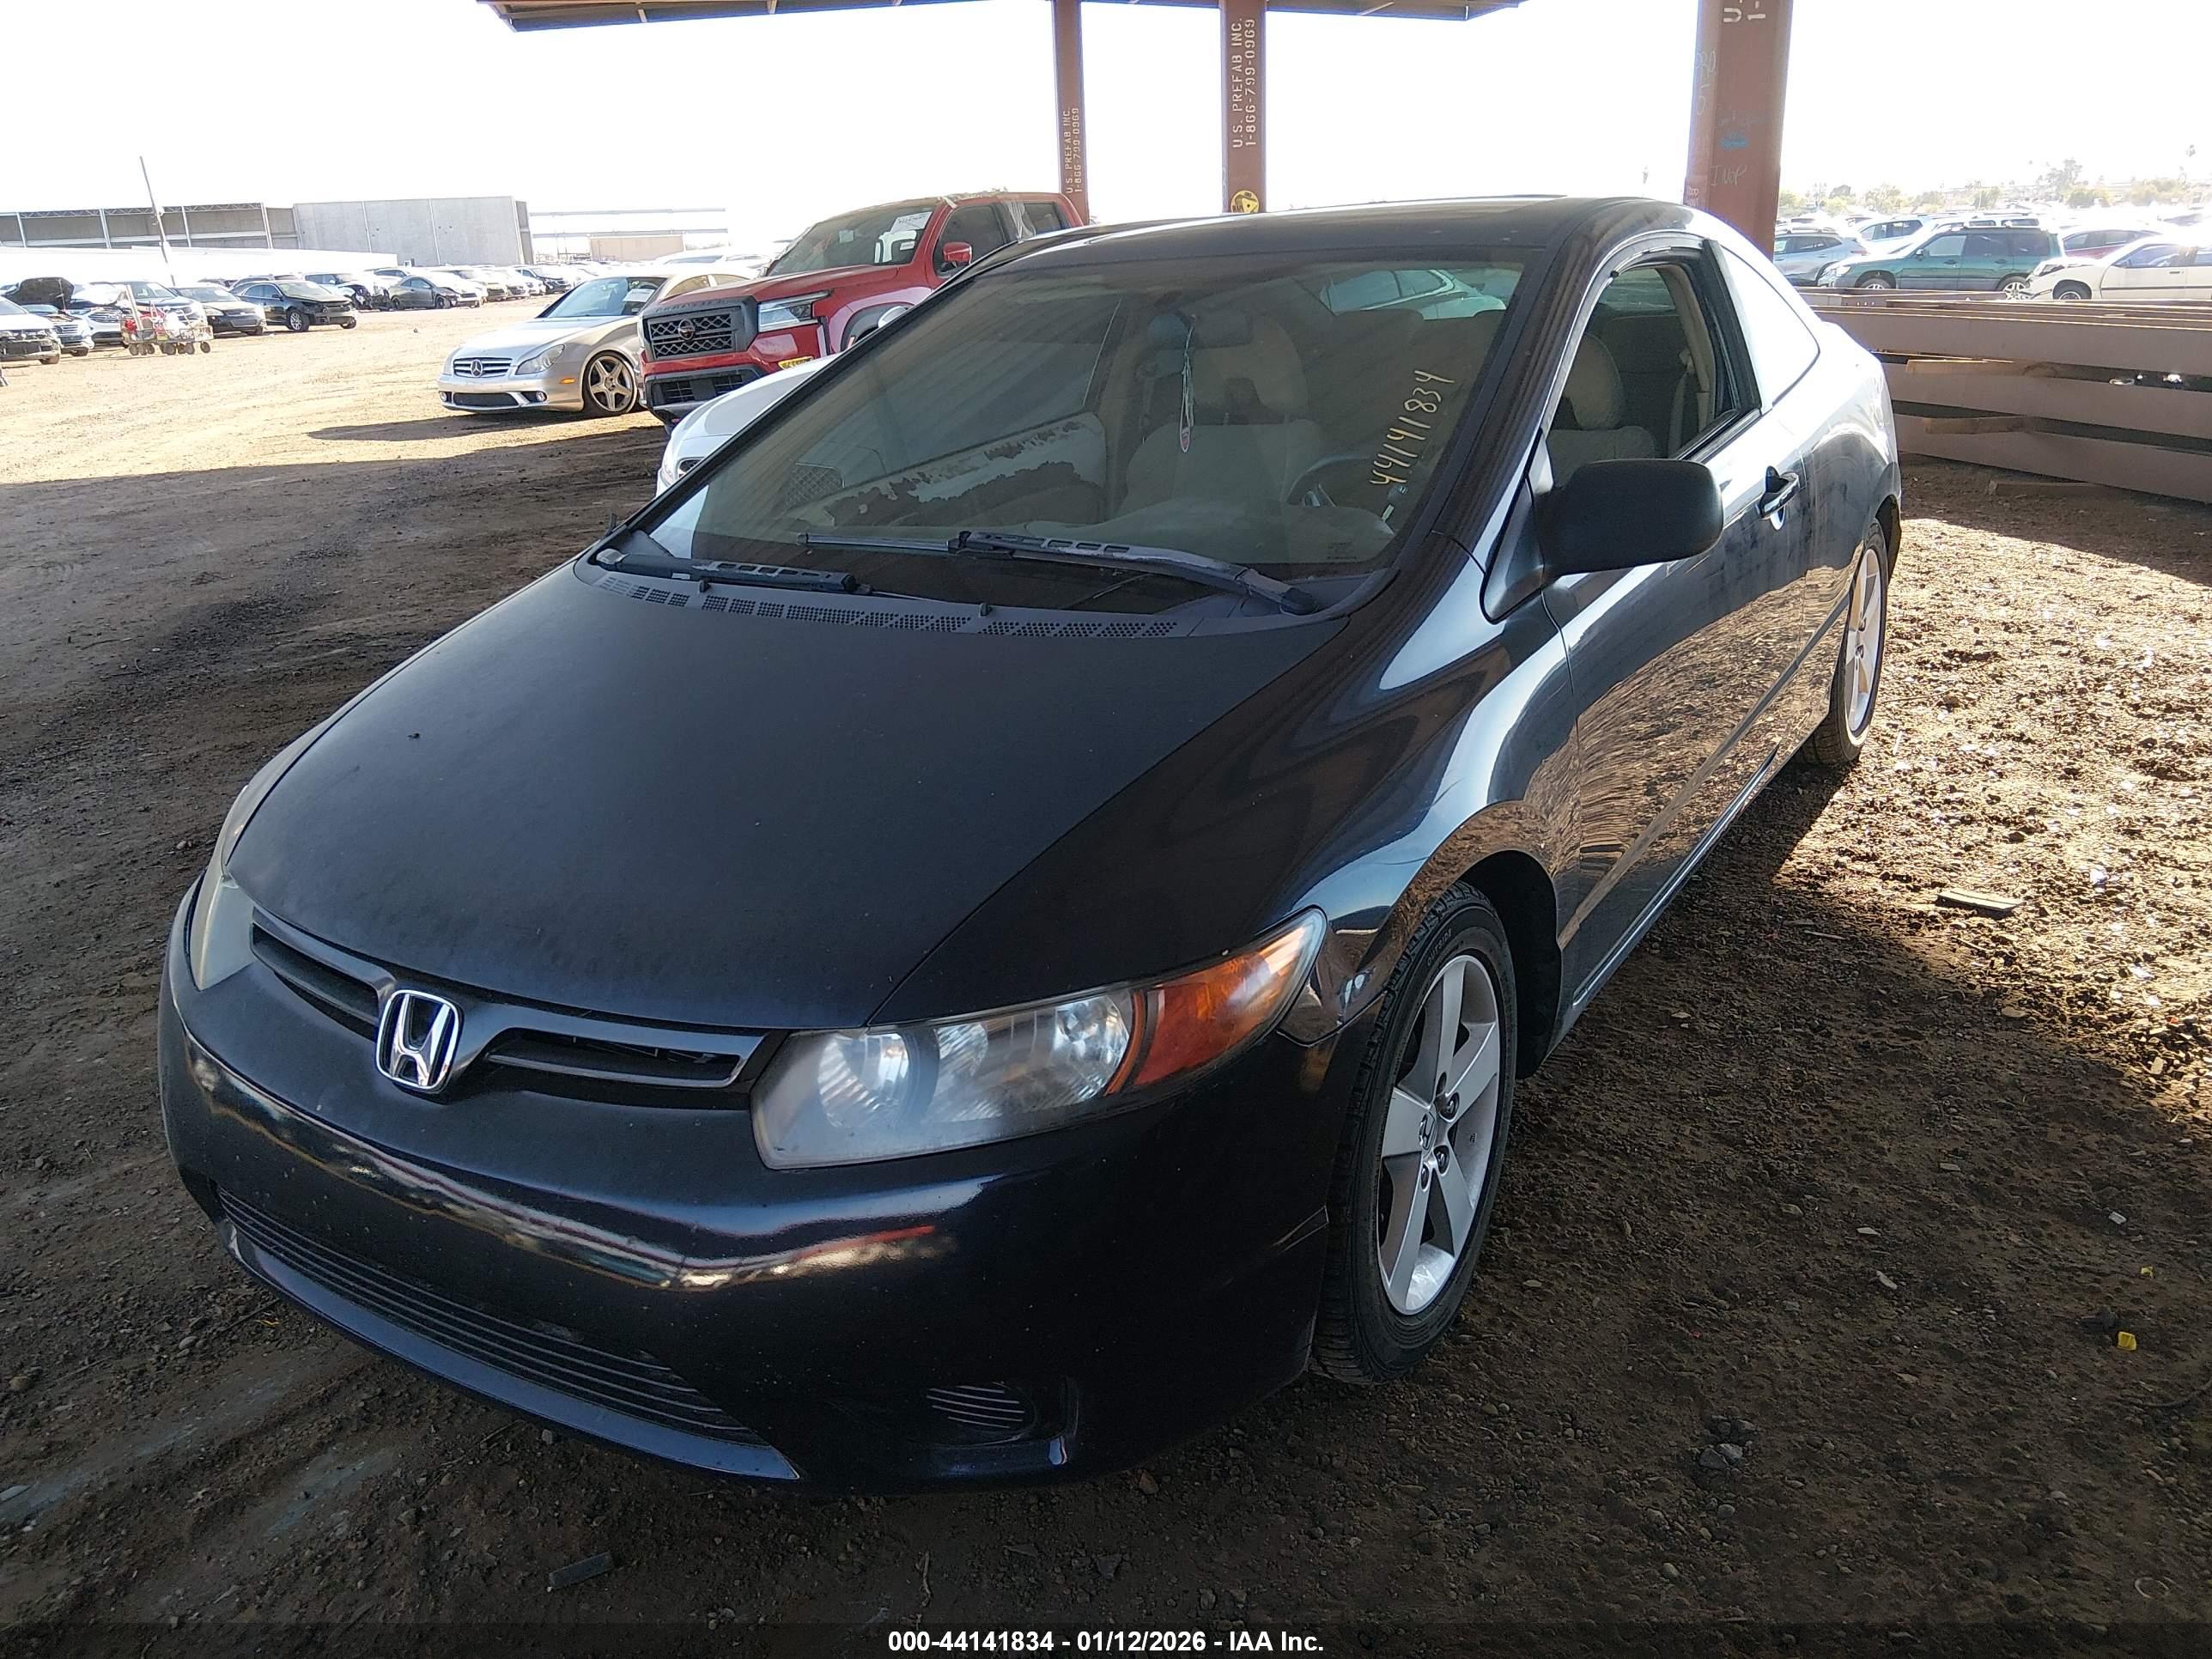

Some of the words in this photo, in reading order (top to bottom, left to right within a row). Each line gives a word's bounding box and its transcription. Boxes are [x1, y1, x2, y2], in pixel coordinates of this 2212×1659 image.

[1231, 17, 1243, 46] INC.
[1231, 54, 1243, 112] PREFAB
[1244, 19, 1256, 146] 1-866-799-0969
[1064, 131, 1073, 170] PREFAB
[1232, 120, 1243, 148] U.S.
[1369, 370, 1455, 484] 44141834
